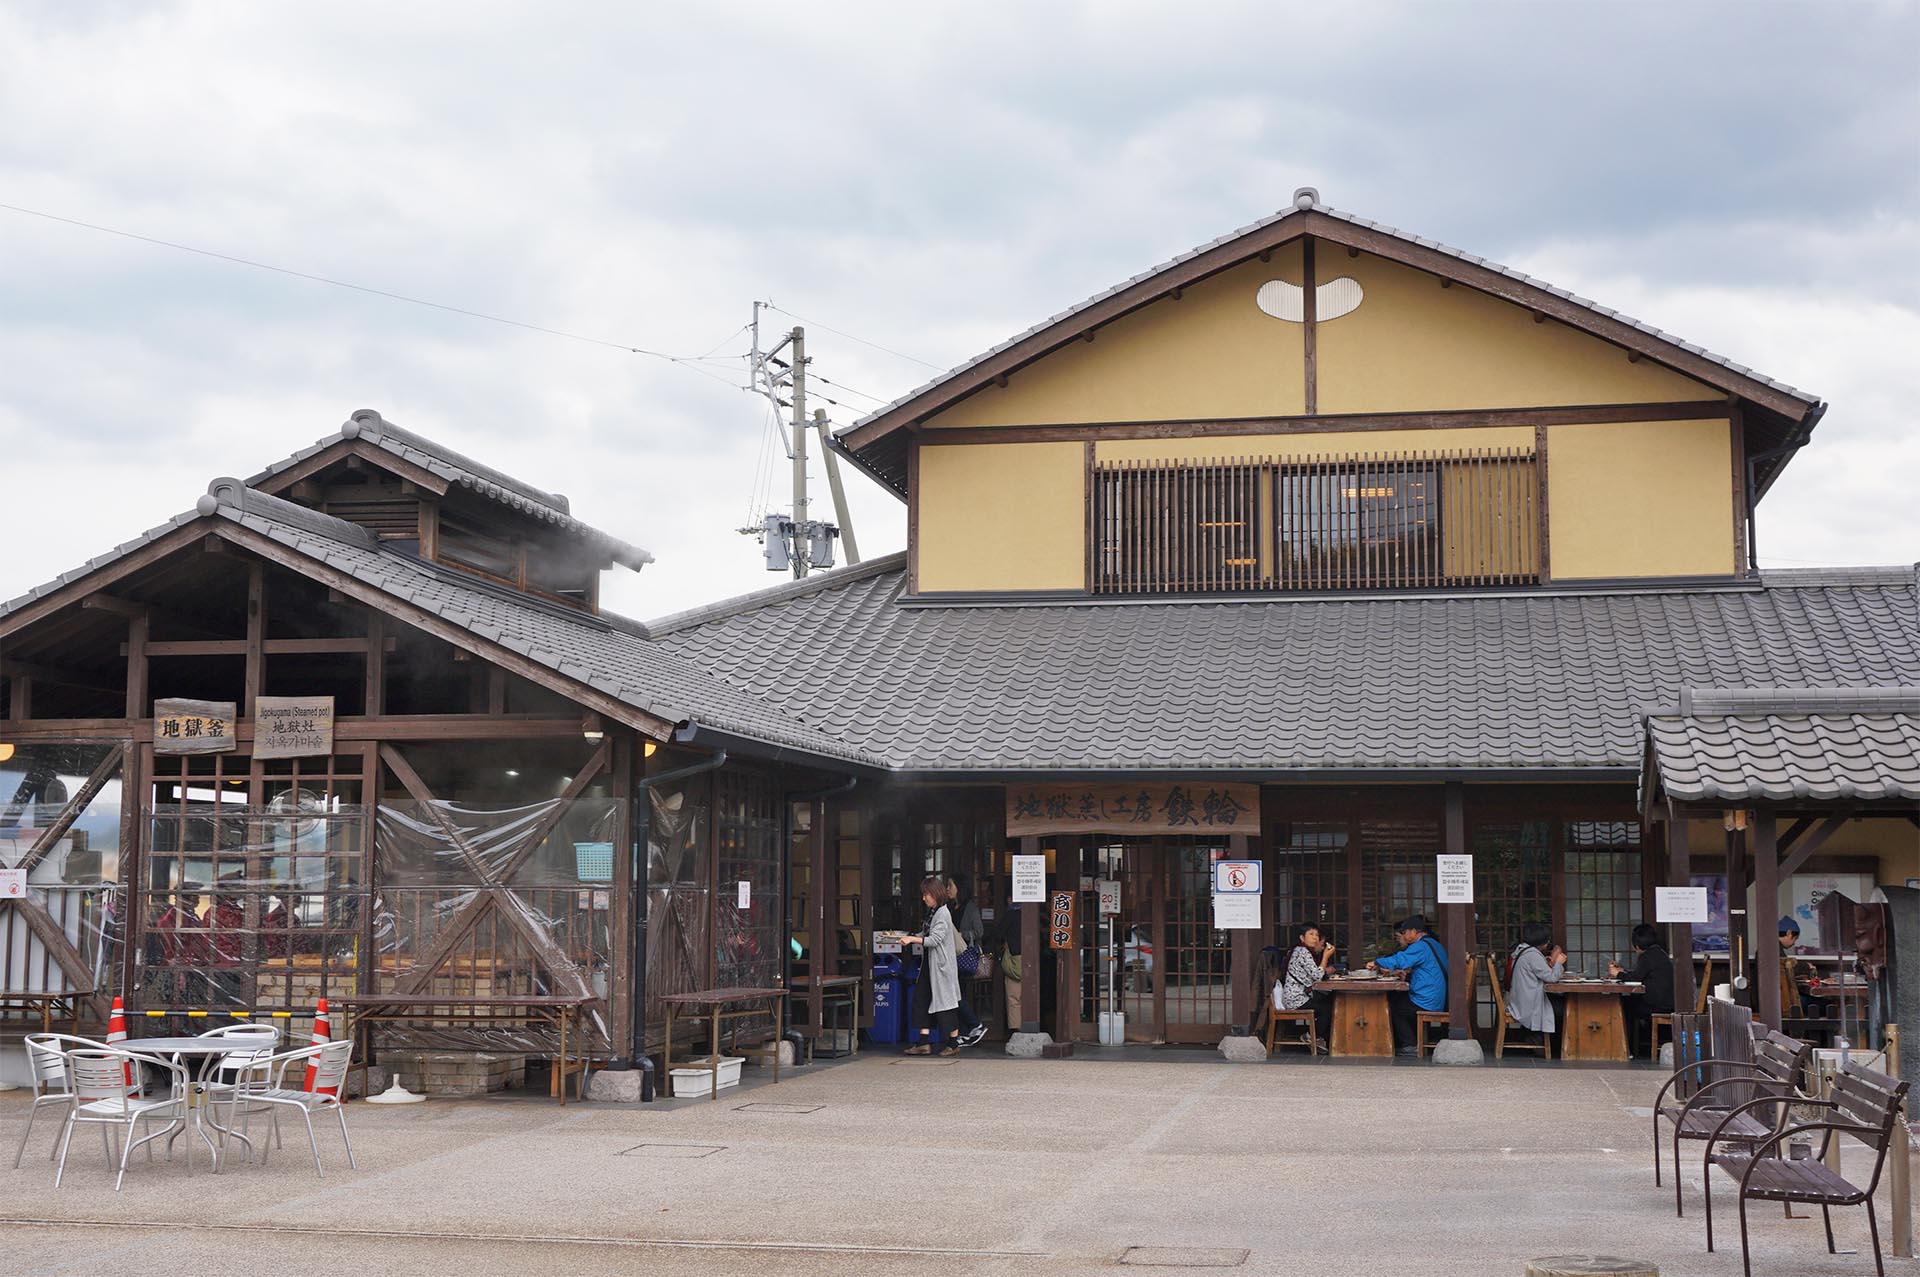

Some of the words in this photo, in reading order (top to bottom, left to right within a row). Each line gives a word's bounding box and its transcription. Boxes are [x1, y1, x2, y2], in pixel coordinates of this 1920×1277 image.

[260, 707, 291, 719] Jigokugama
[292, 706, 318, 717] (Steamed
[319, 705, 330, 718] pot)
[162, 718, 225, 738] 地獄釜
[1101, 894, 1113, 903] 20
[1053, 893, 1071, 947] 商い中
